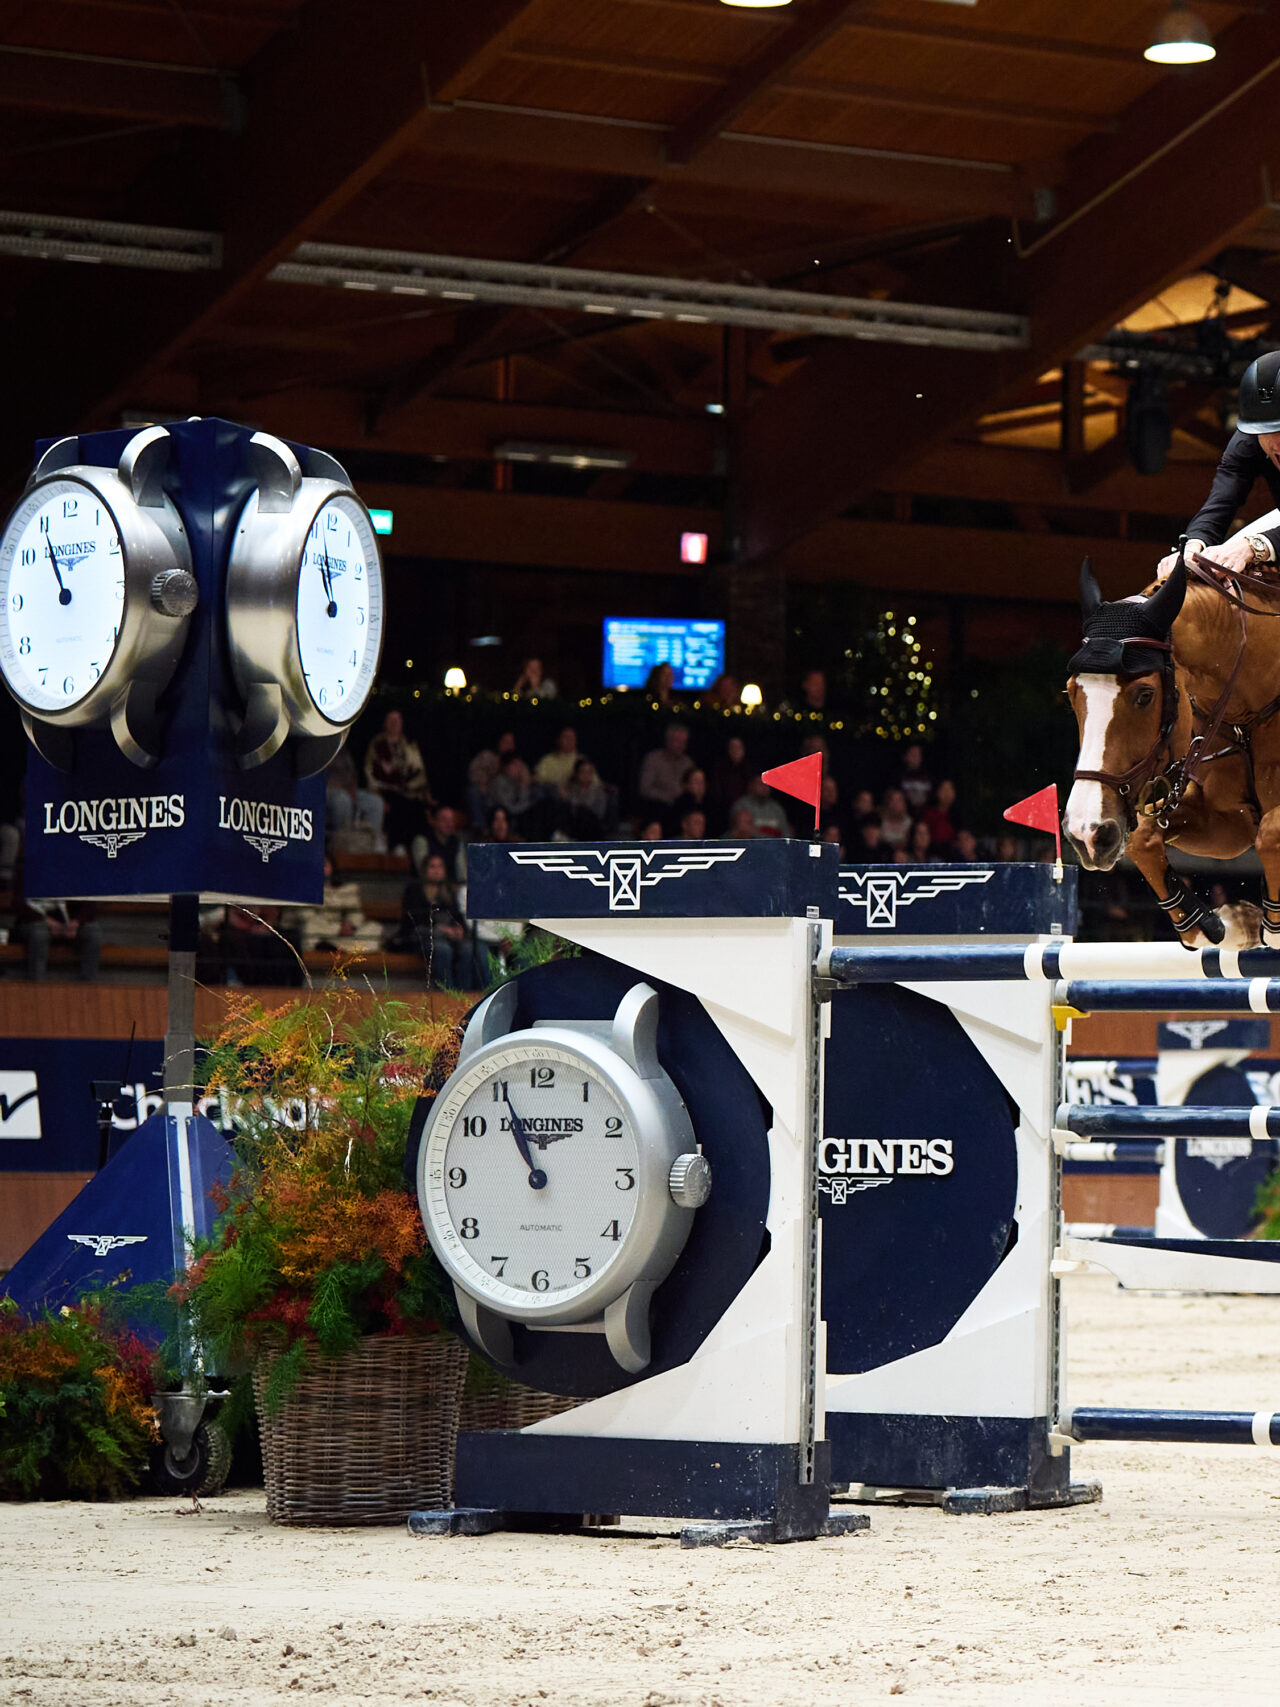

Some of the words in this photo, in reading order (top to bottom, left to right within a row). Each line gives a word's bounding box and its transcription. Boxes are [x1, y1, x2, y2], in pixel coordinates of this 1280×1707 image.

[62, 499, 78, 518] 12
[96, 508, 99, 526] 1
[327, 512, 337, 531] 12
[109, 536, 121, 555] 2
[347, 529, 351, 547] 1
[21, 547, 36, 566] 10
[354, 562, 362, 580] 2
[12, 593, 23, 612] 9
[357, 606, 365, 625] 3
[19, 635, 31, 655] 8
[349, 649, 357, 667] 4
[38, 667, 49, 686] 7
[89, 660, 100, 680] 5
[63, 675, 75, 695] 6
[337, 679, 344, 697] 5
[319, 687, 327, 706] 6
[44, 794, 185, 834] LONGINES
[219, 796, 313, 841] LONGINES
[529, 1067, 555, 1088] 12
[493, 1081, 508, 1102] 11
[582, 1081, 589, 1102] 1
[462, 1115, 487, 1137] 10
[500, 1117, 584, 1132] LNGINES
[604, 1116, 623, 1138] 2
[818, 1137, 954, 1175] GINES
[449, 1167, 467, 1189] 9
[615, 1168, 635, 1190] 3
[460, 1217, 480, 1239] 8
[520, 1224, 562, 1232] AUTOMATIC
[600, 1219, 622, 1241] 4
[491, 1255, 509, 1277] 7
[574, 1256, 592, 1279] 5
[531, 1269, 550, 1291] 6
